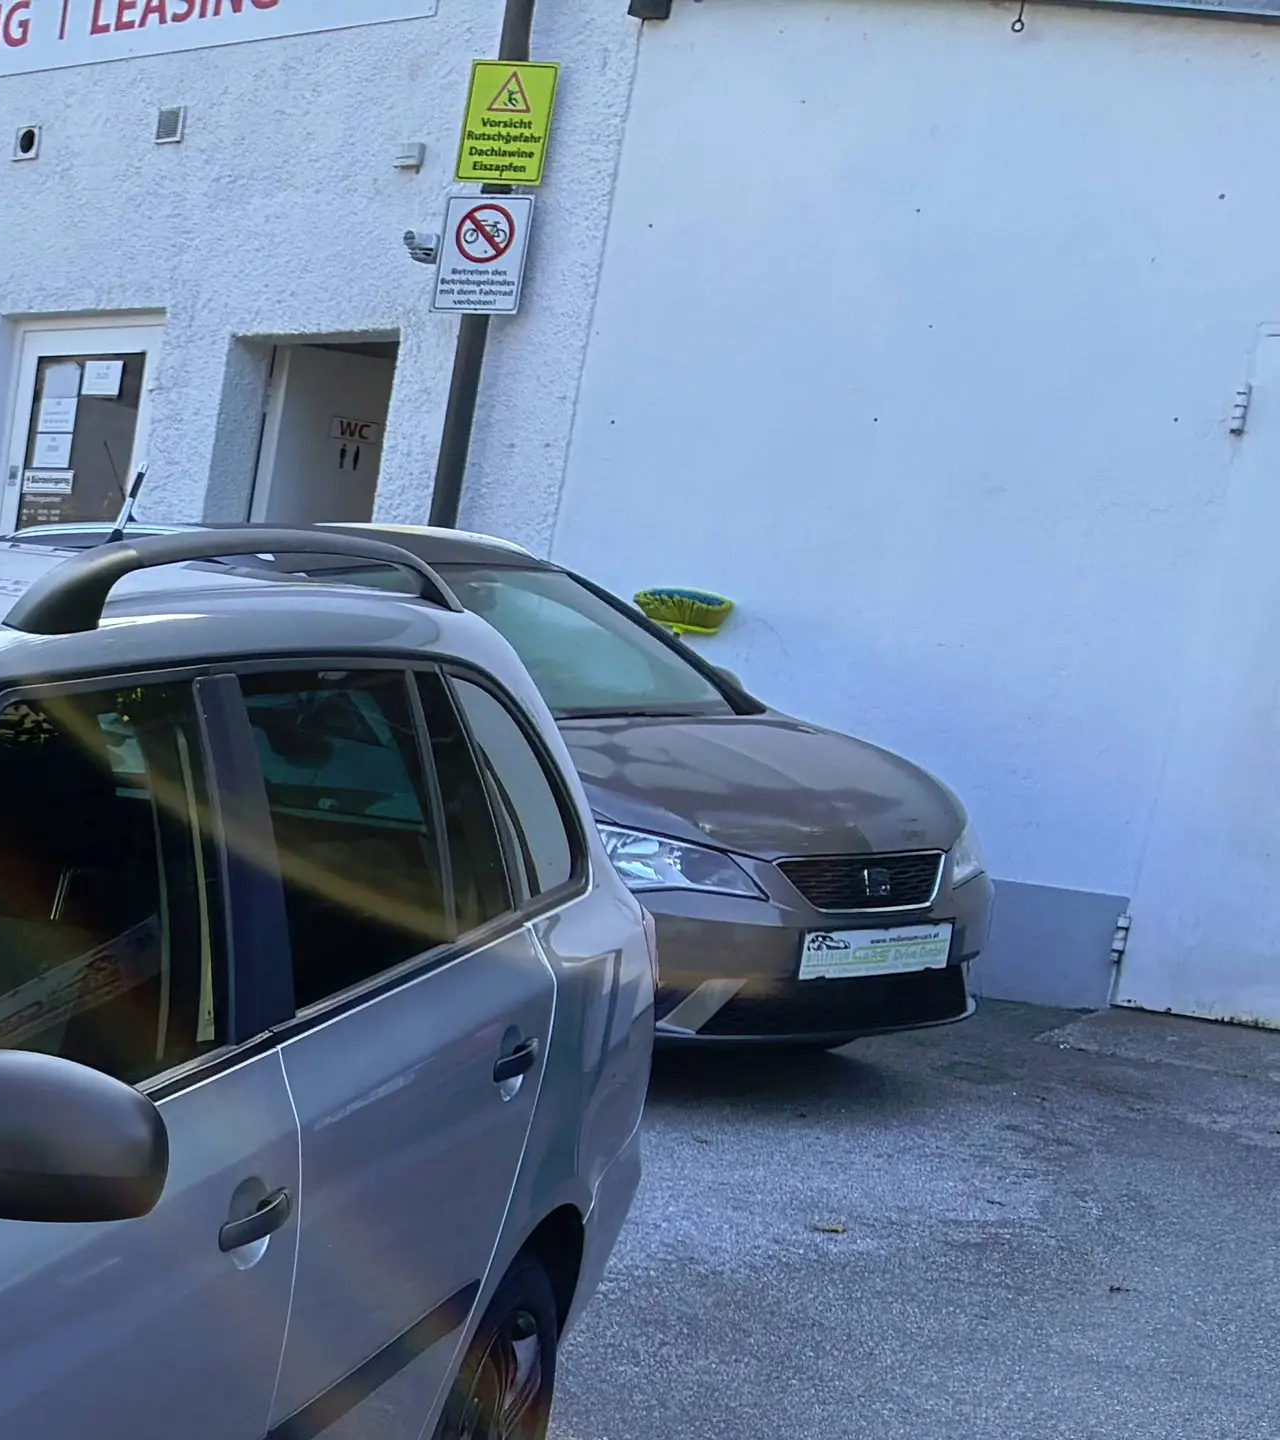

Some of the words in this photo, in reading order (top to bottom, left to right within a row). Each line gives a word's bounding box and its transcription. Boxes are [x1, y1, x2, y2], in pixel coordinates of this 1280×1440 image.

[481, 117, 533, 129] Vorsicht
[467, 130, 542, 144] Rutschgefahr
[468, 146, 535, 159] Dachlawine
[472, 161, 527, 177] Eiszapfen
[339, 420, 371, 440] WC
